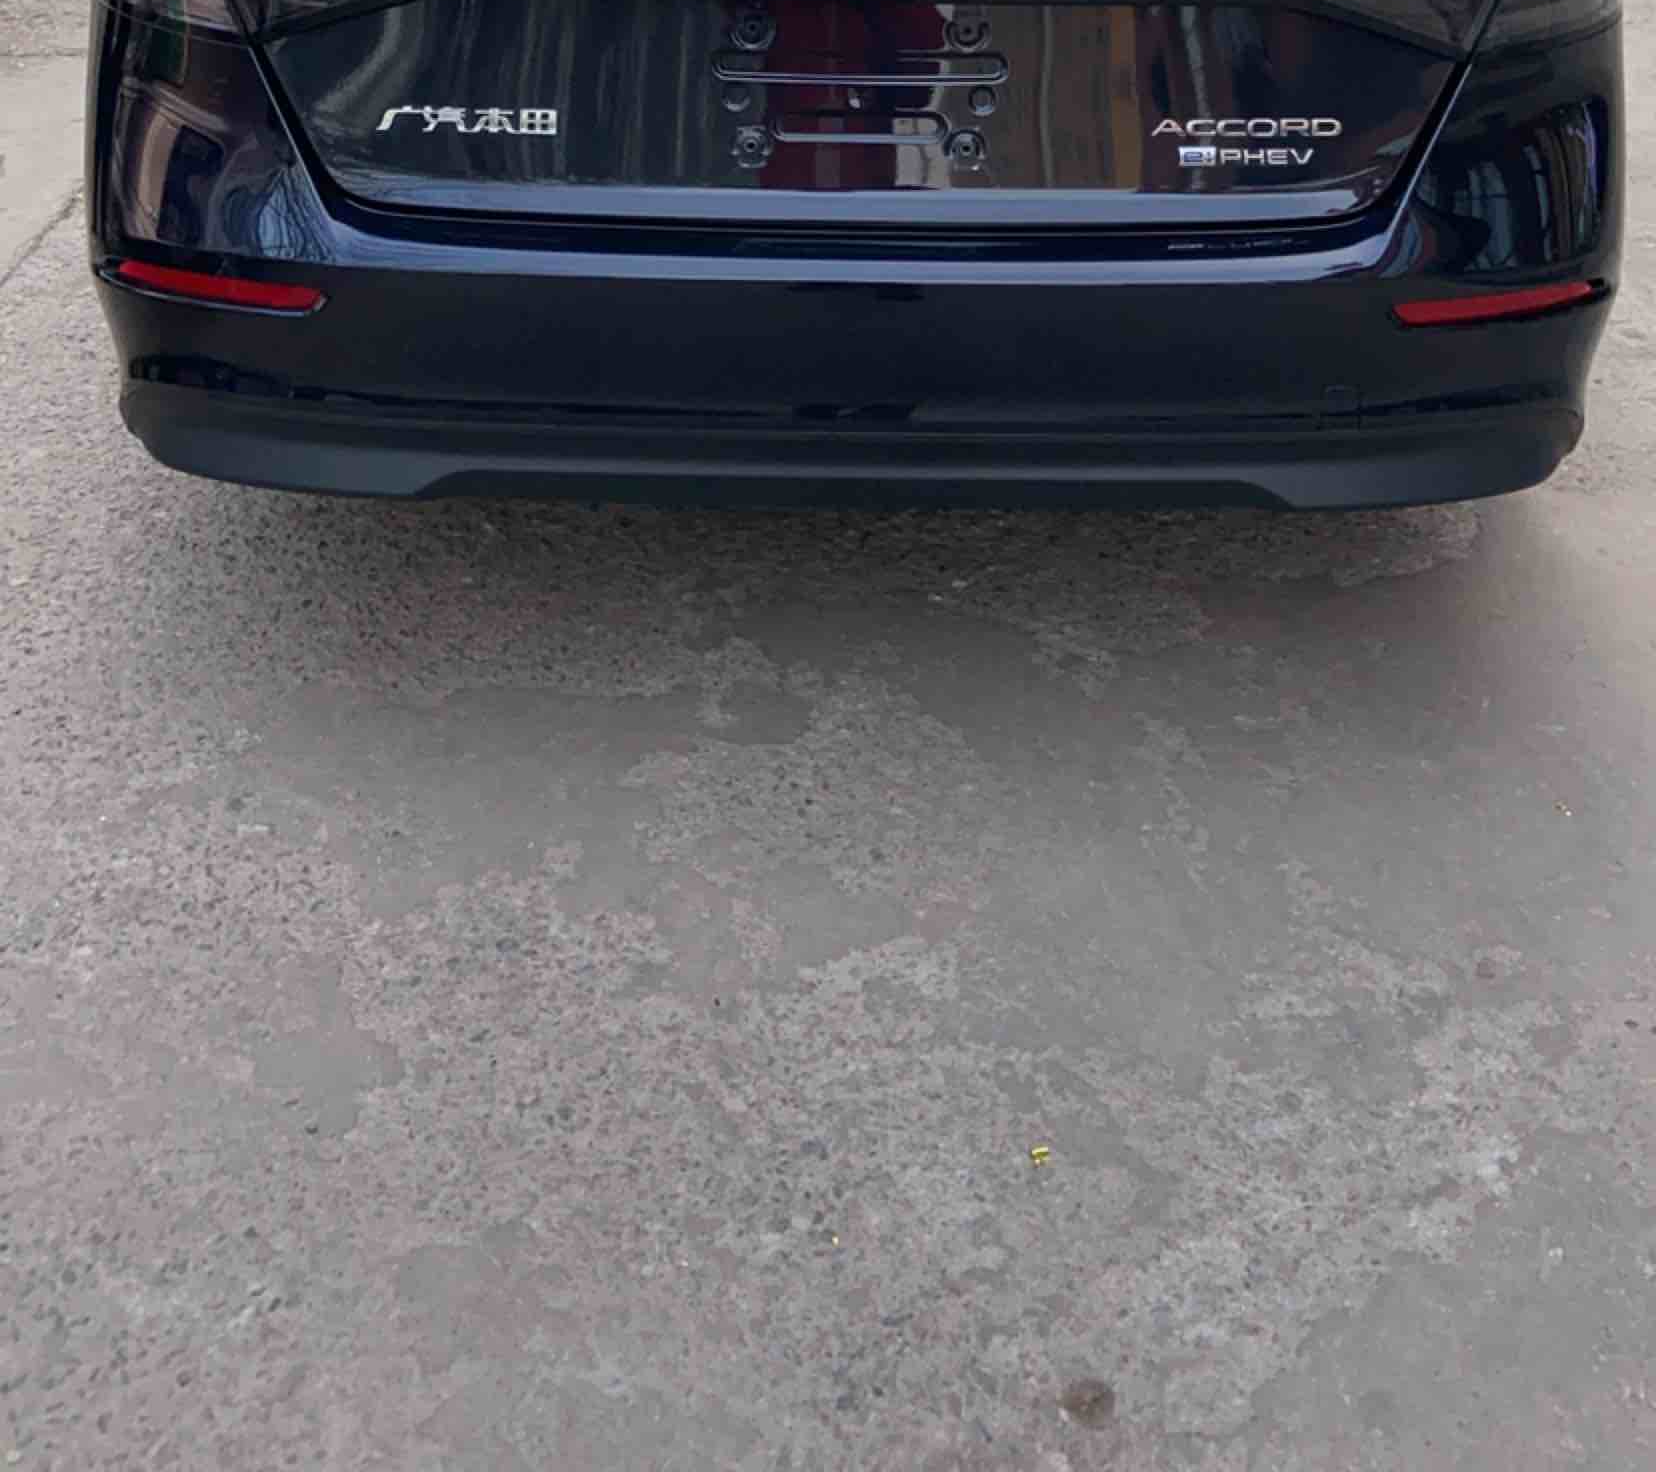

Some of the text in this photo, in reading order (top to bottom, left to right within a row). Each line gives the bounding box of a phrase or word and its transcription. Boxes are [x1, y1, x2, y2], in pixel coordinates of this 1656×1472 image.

[375, 105, 558, 135] 广汽本田
[1151, 117, 1343, 137] ACCORD
